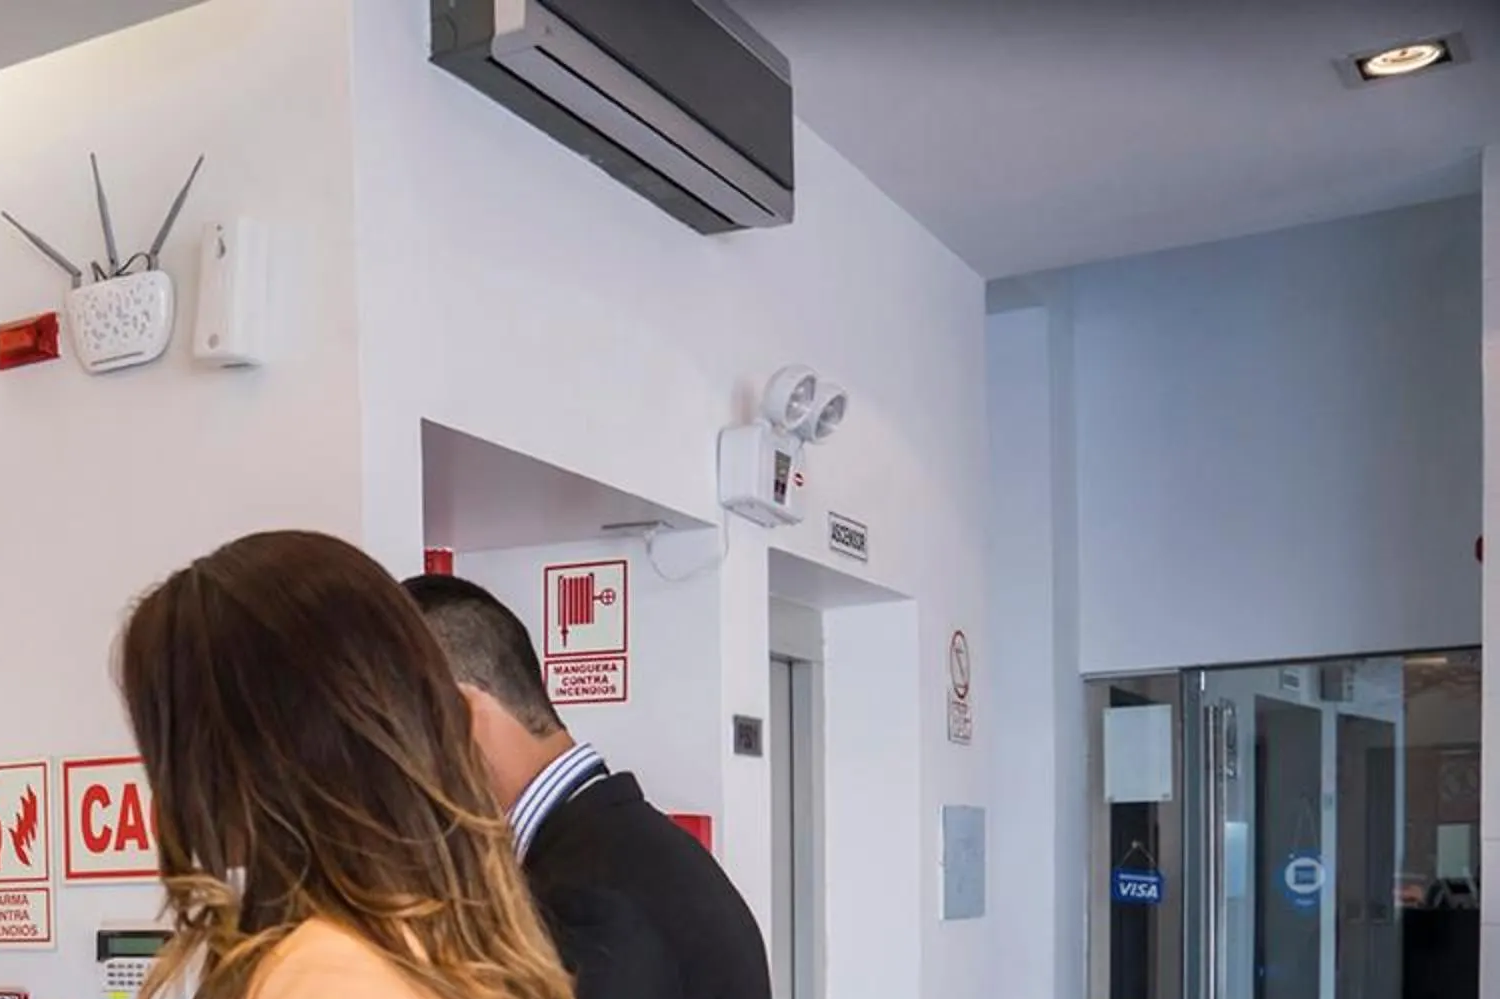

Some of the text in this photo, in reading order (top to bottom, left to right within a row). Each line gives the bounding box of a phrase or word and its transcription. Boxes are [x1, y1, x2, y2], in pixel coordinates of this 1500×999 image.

[561, 674, 609, 686] CONTRA
[555, 684, 616, 697] INCENDIOS
[81, 783, 161, 853] CA
[1119, 882, 1159, 899] VISA
